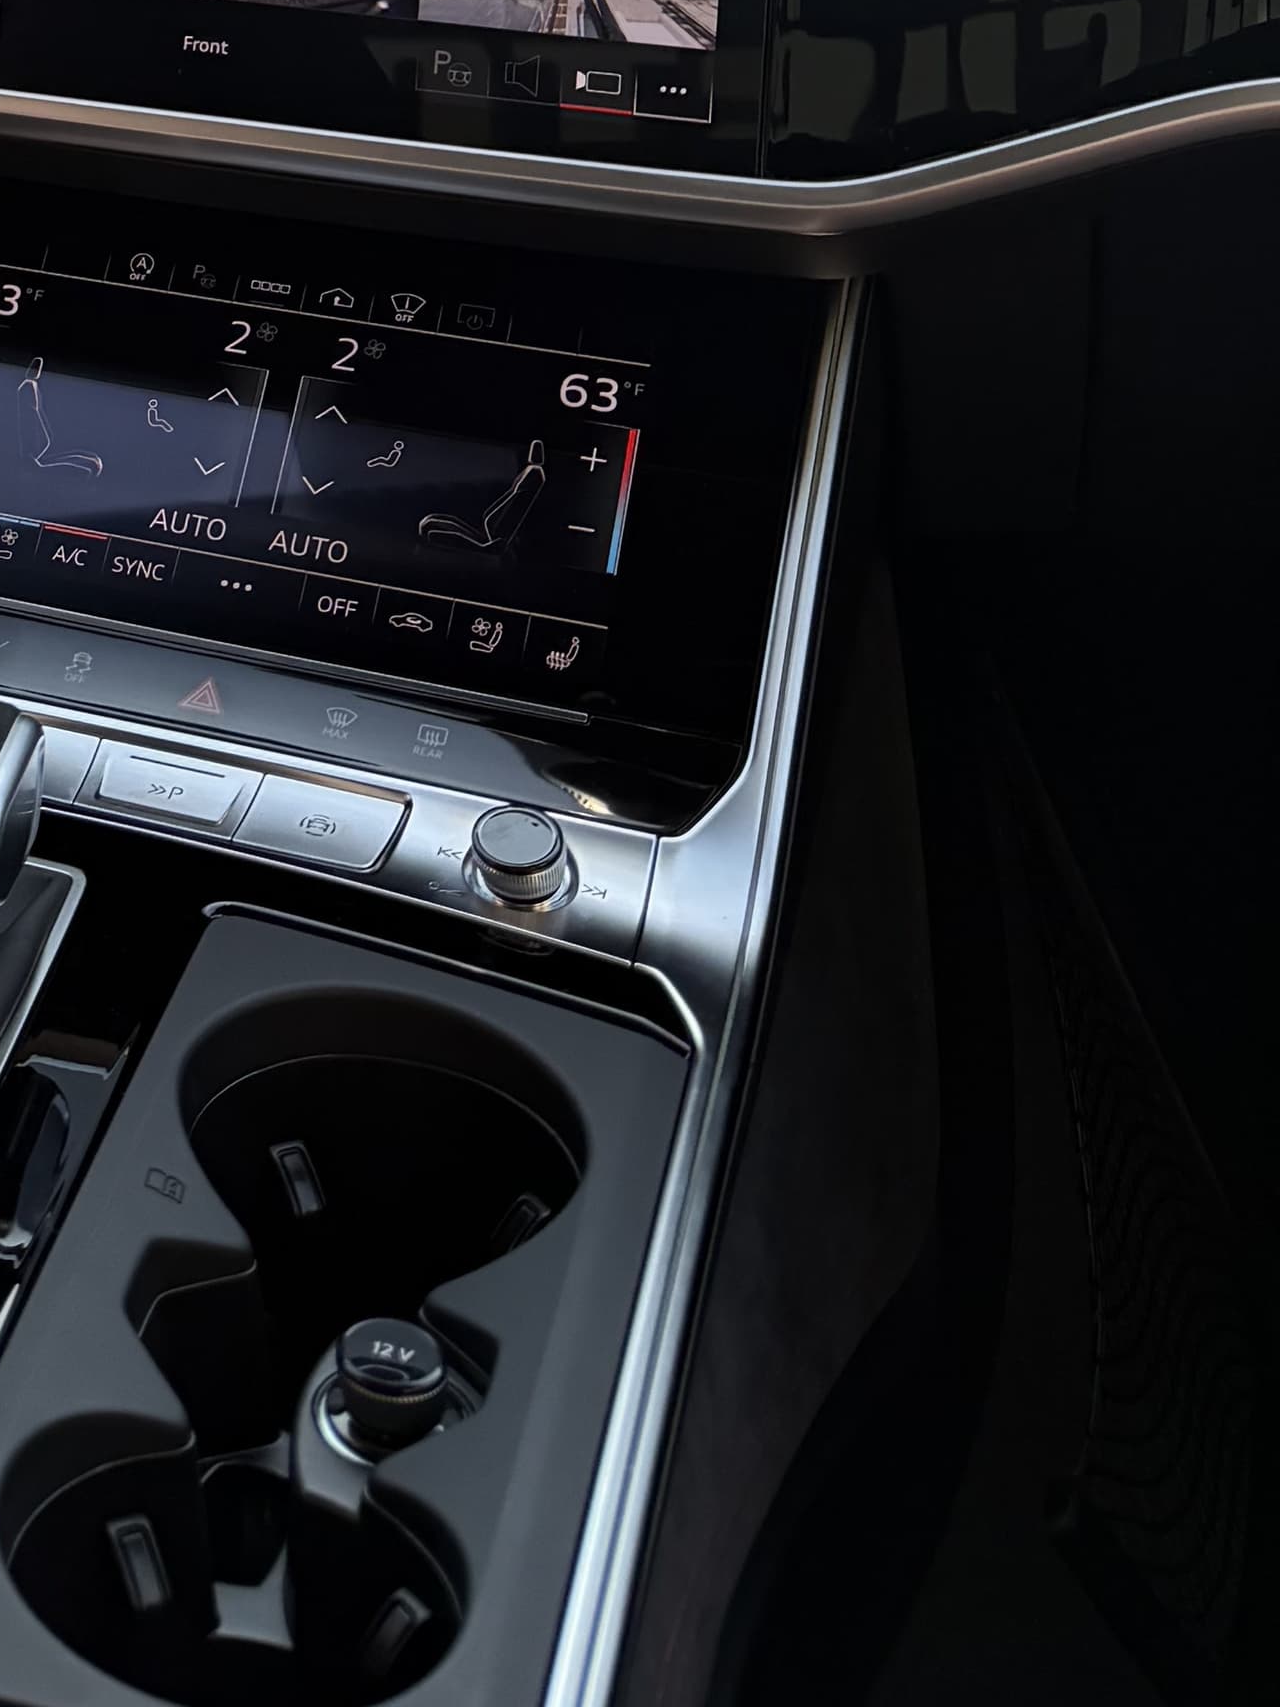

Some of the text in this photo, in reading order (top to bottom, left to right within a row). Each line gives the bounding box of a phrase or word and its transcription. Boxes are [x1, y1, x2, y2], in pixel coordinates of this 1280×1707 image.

[183, 35, 229, 55] Front
[136, 257, 148, 270] A
[129, 272, 147, 282] OFF
[394, 313, 416, 324] OFF
[224, 320, 252, 355] 2
[331, 337, 359, 372] 2
[149, 508, 227, 541] AUTO
[52, 545, 88, 567] A/C
[268, 530, 349, 564] AUTO
[111, 556, 166, 582] SYNC
[317, 595, 359, 618] OFF
[322, 726, 350, 740] MAX
[412, 746, 445, 761] REAR
[373, 1341, 416, 1362] 12 V
